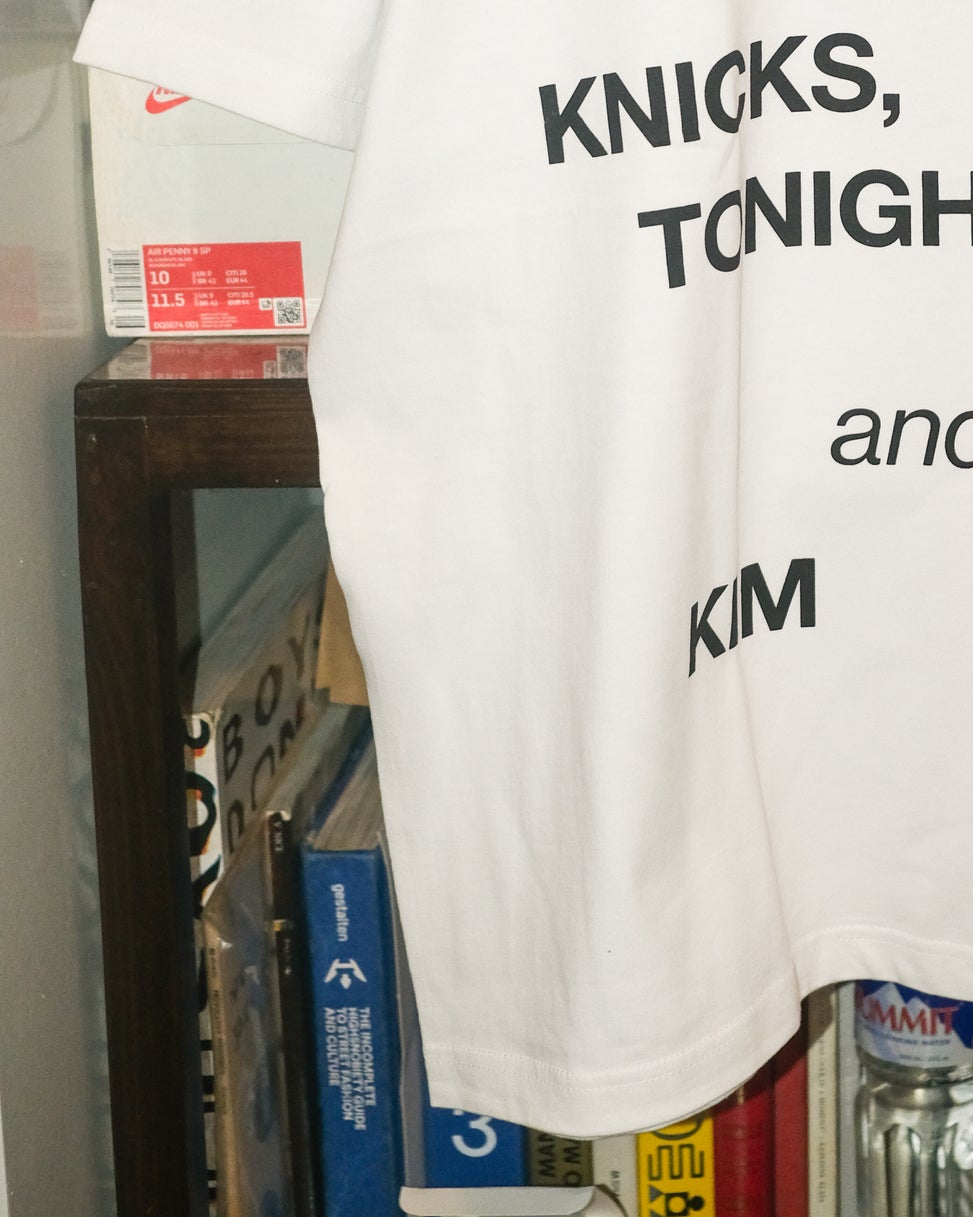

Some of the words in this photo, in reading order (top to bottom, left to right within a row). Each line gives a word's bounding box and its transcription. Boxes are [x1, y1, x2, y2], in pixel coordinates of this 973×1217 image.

[538, 32, 901, 165] KNICKS,
[150, 270, 170, 285] 10
[151, 293, 185, 308] 11.5
[688, 558, 816, 678] KIM
[331, 884, 349, 942] gestalten
[324, 1008, 336, 1033] AND
[336, 1008, 348, 1024] TO
[360, 1008, 370, 1030] THE
[326, 1035, 340, 1086] CULTURE
[338, 1026, 351, 1066] STREET
[348, 1008, 364, 1094] HIGHSNOBIETY
[361, 1032, 376, 1106] INCOMPLETE
[341, 1070, 354, 1120] FASHION
[354, 1096, 366, 1130] GUIDE
